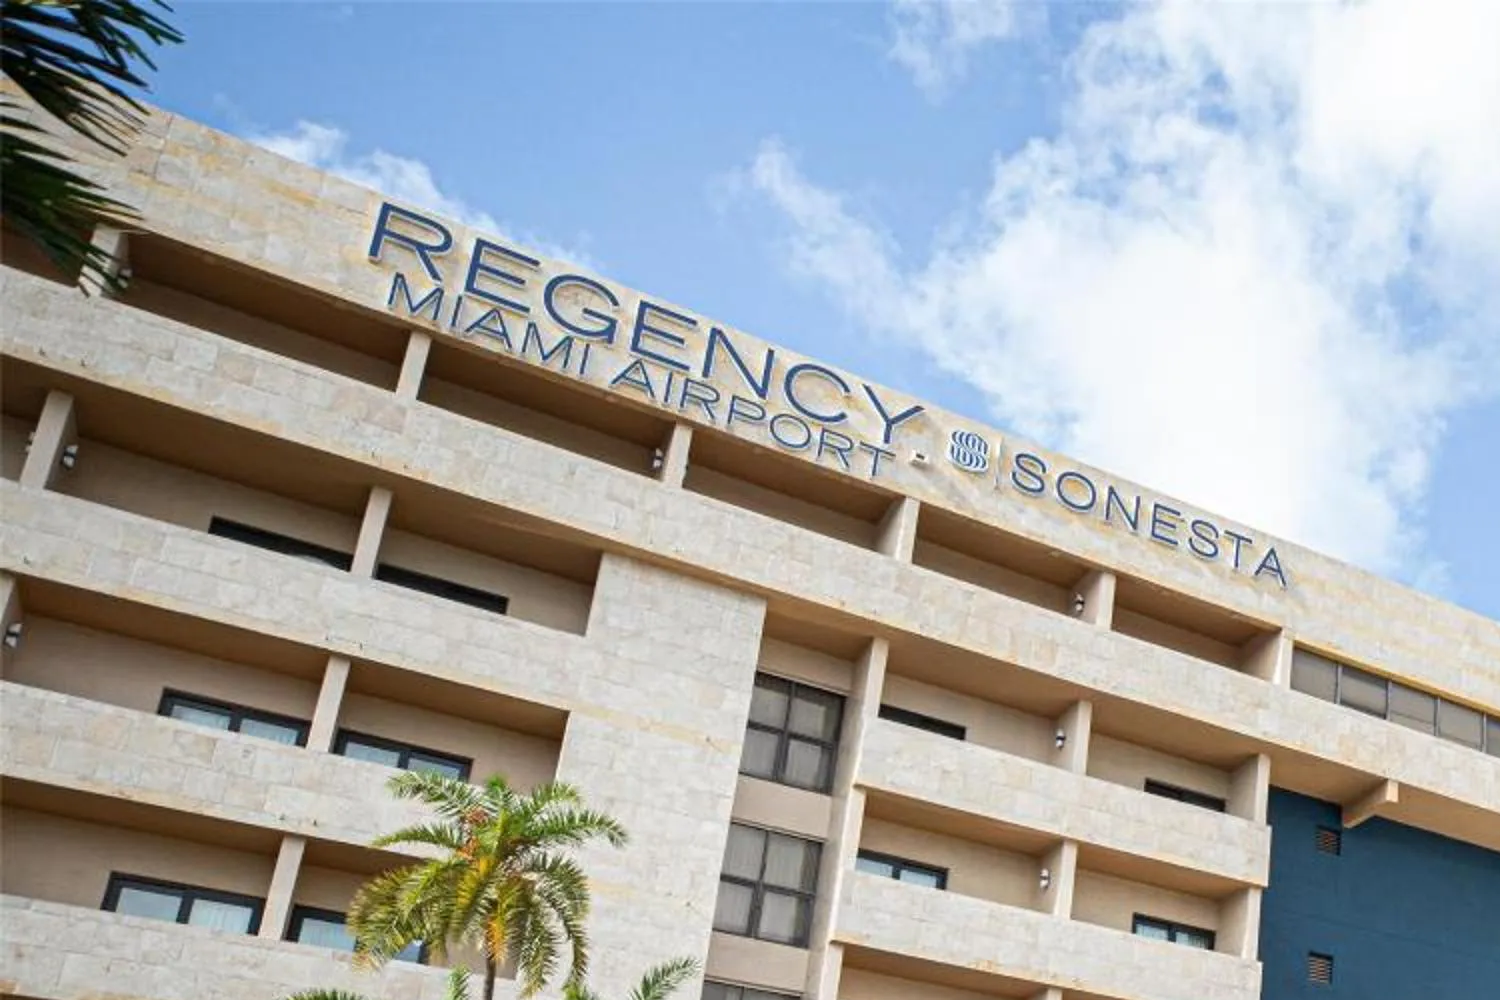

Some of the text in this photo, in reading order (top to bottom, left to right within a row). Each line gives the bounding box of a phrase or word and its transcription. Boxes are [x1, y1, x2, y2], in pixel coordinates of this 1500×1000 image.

[368, 202, 925, 446] REGENCY
[387, 272, 896, 478] MIAMI AIRPORT
[1011, 452, 1287, 587] SONESTA
